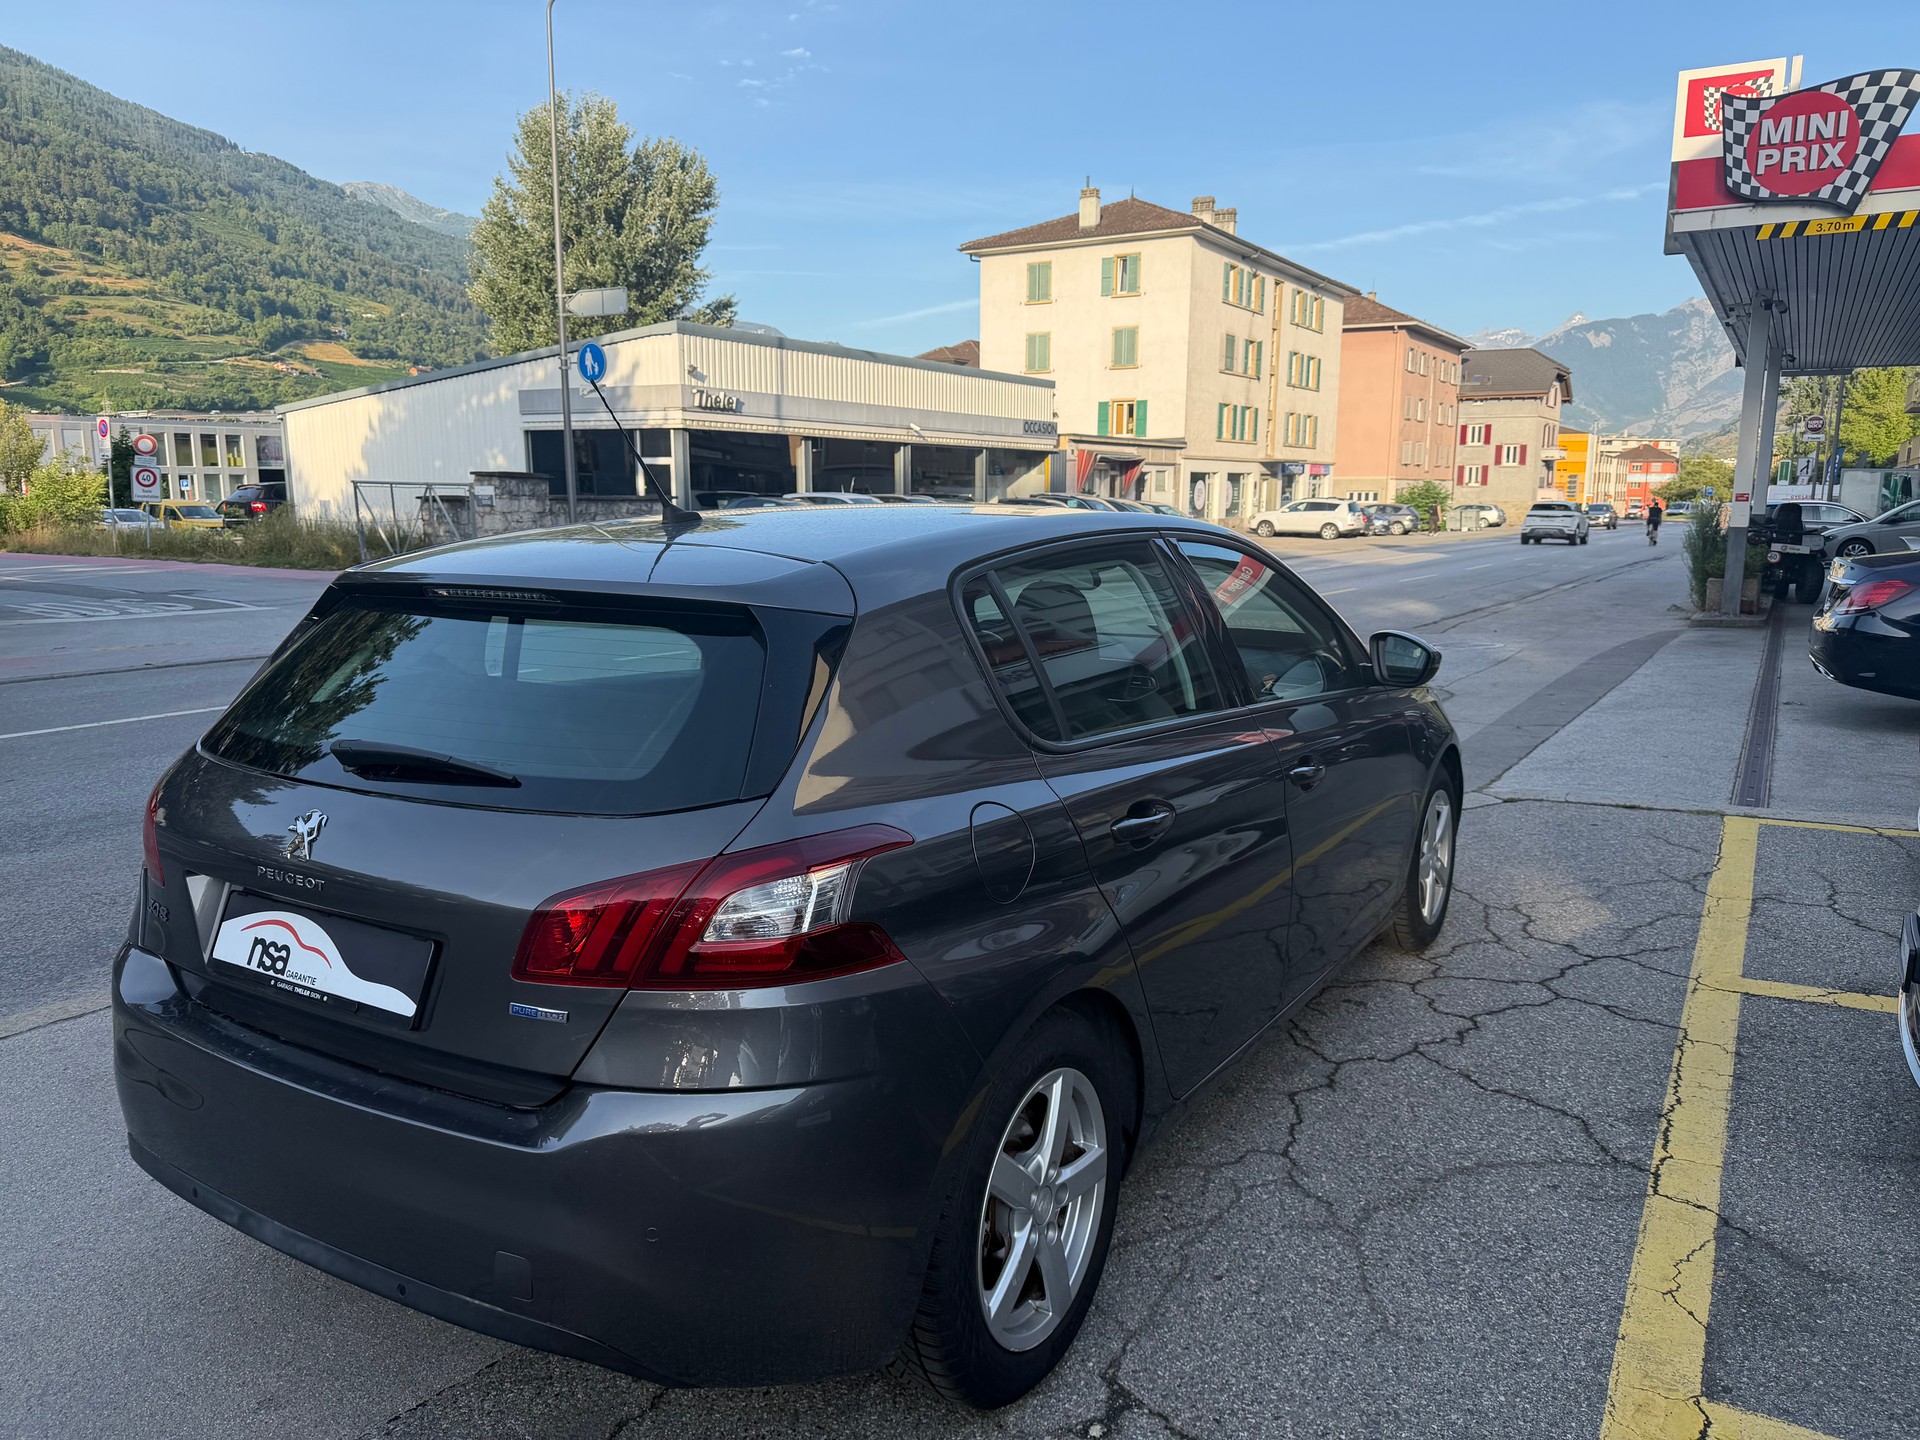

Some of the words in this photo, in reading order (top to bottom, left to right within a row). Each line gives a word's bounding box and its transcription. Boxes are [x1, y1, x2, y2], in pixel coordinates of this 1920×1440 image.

[1759, 109, 1849, 146] MINI
[1756, 141, 1847, 176] PRIX
[1816, 221, 1841, 232] 3.70
[1843, 221, 1855, 230] m
[691, 388, 739, 410] Theler
[141, 474, 151, 482] 40
[257, 865, 326, 891] PEUGEOT
[246, 936, 291, 977] nsa
[285, 970, 317, 986] GARANTIE
[276, 981, 294, 992] GARAGE
[294, 986, 311, 997] THELER
[310, 991, 321, 1000] SION
